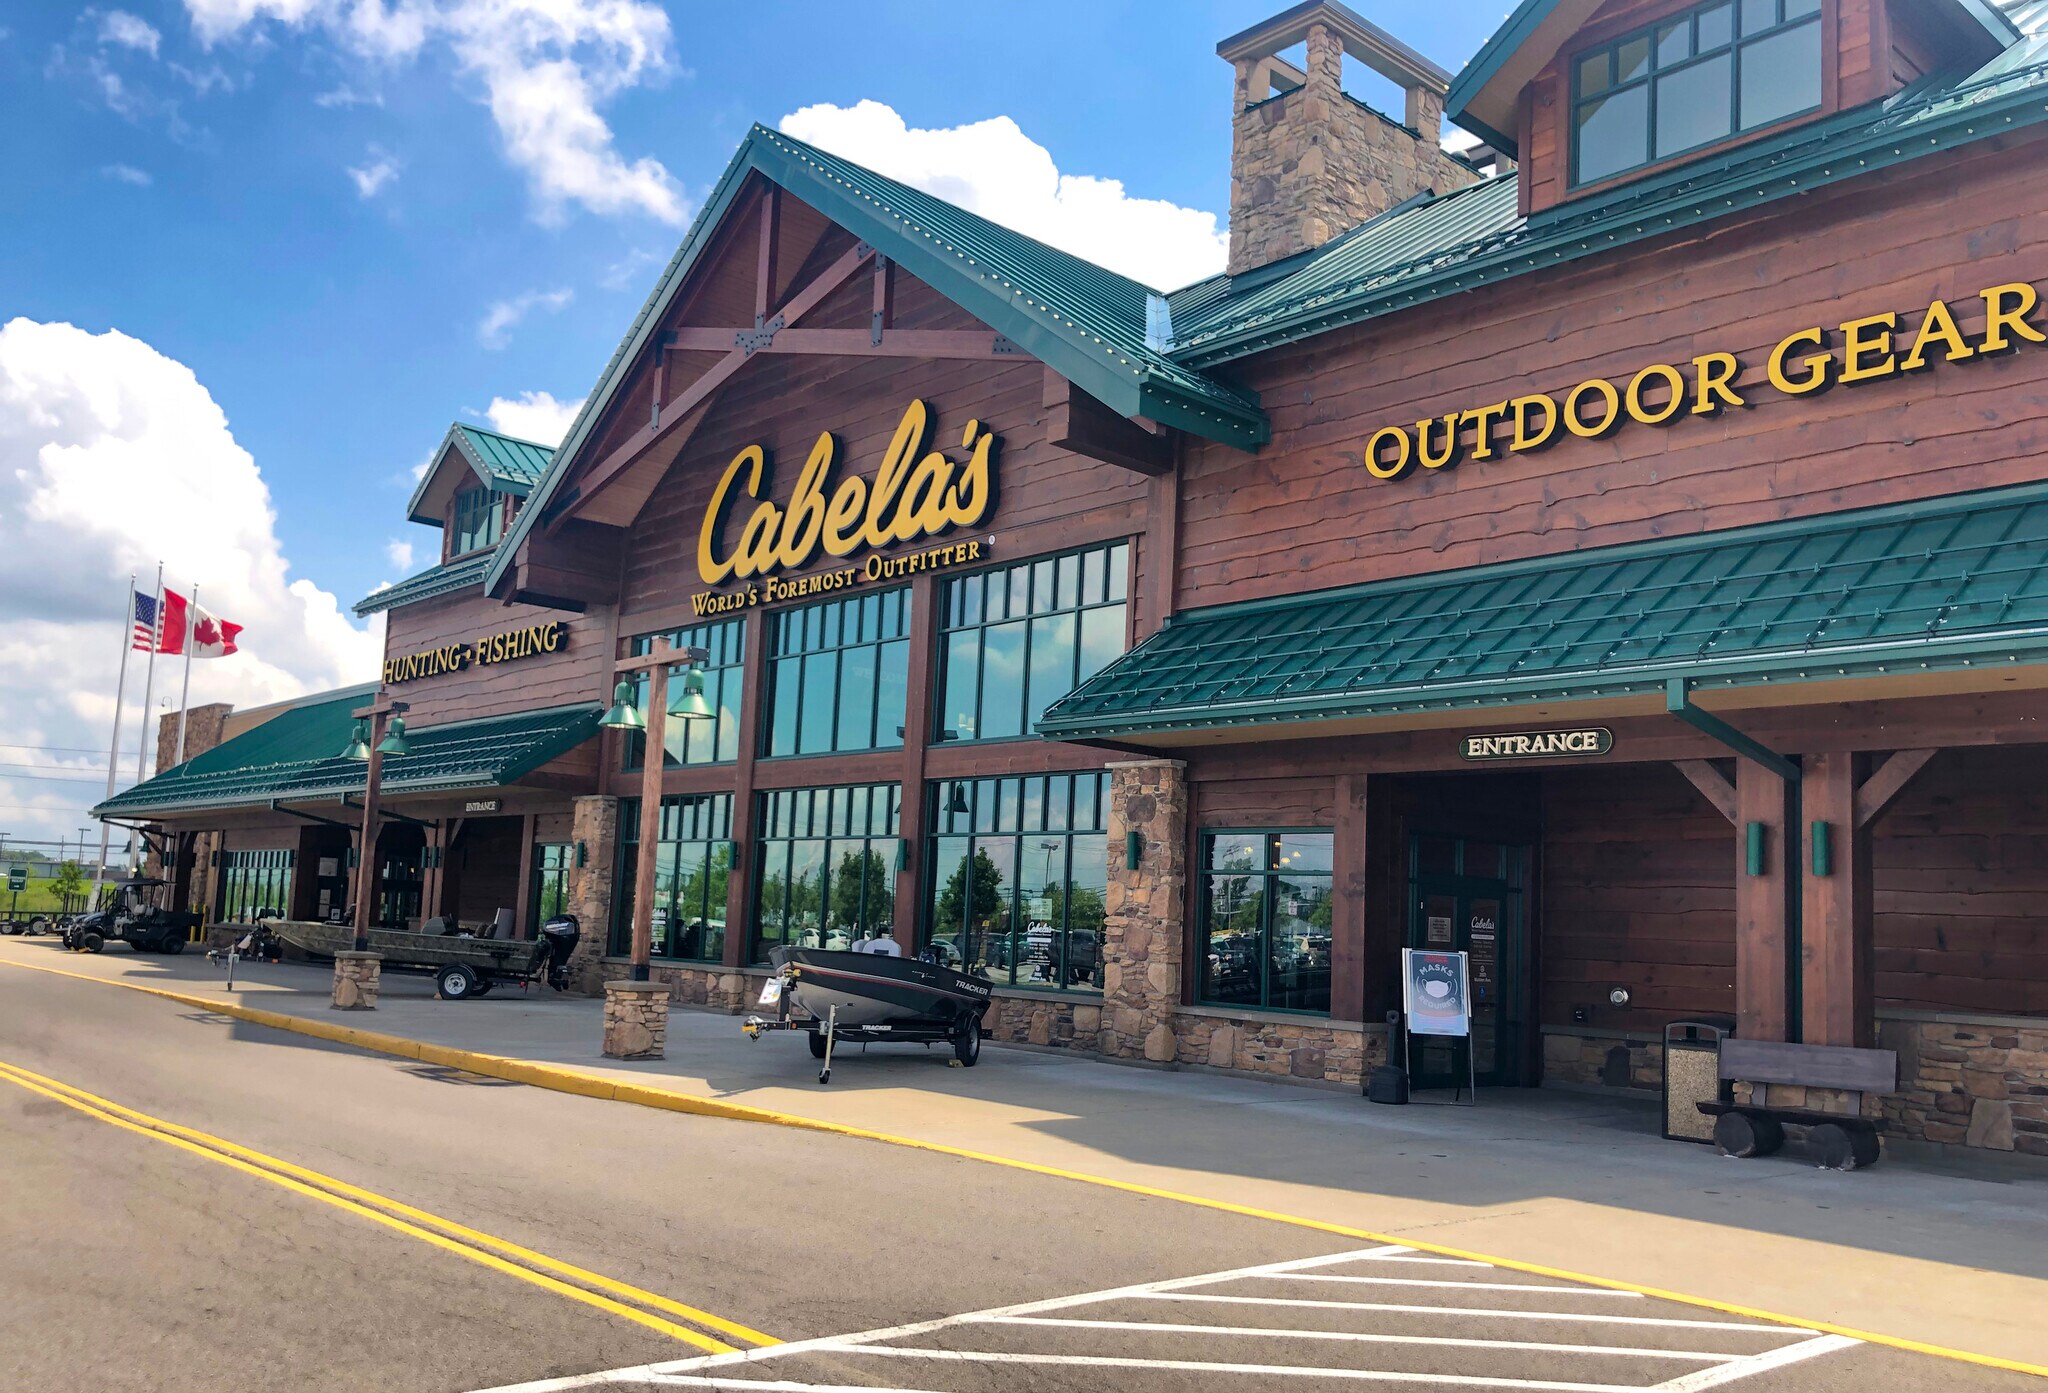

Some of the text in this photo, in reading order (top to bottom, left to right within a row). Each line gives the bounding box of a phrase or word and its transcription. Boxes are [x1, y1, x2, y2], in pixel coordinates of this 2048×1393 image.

[1365, 282, 2046, 480] OUTDOOR GEAR
[697, 398, 994, 585] Cabela's
[766, 567, 856, 603] FOREMOST
[865, 540, 980, 581] OUTFITTER
[382, 620, 558, 684] HUNTING FISHING
[1467, 731, 1599, 757] ENTRANCE
[465, 801, 496, 812] ENTRANCE
[1419, 964, 1454, 977] MASKS
[955, 979, 989, 996] TRACKER
[1417, 995, 1456, 1009] REQUIRED
